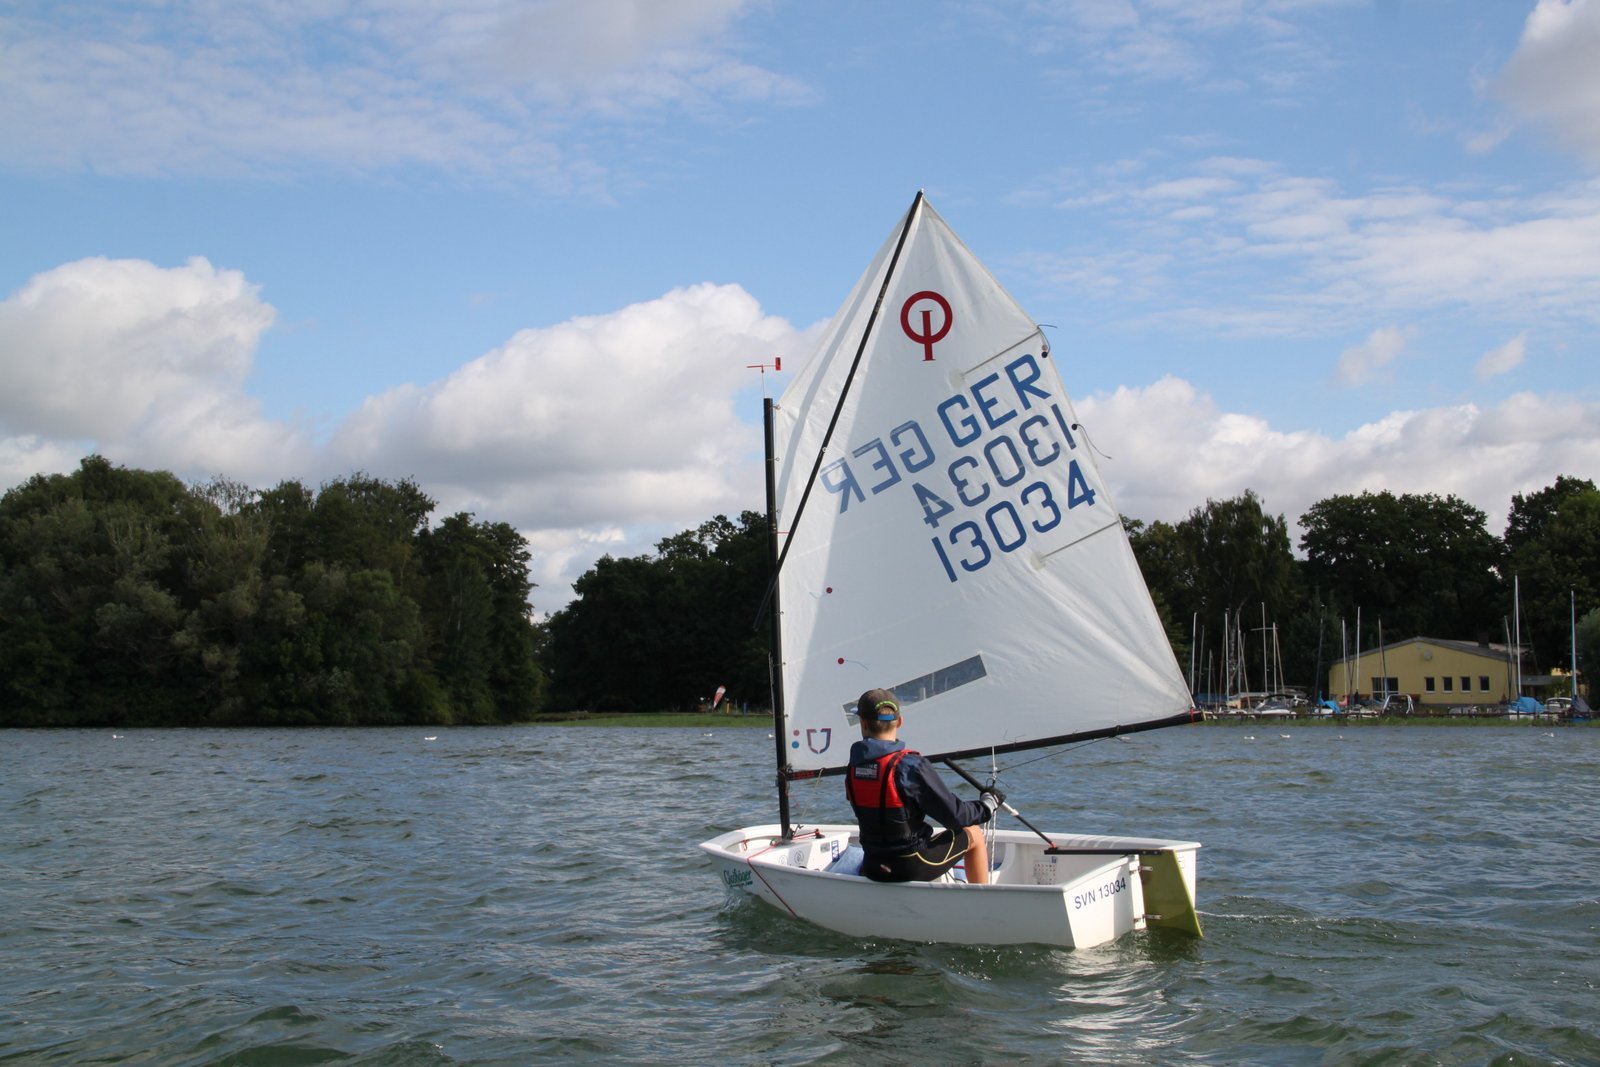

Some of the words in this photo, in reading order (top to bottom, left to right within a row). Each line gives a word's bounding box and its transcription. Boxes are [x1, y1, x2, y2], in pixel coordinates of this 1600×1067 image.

[937, 354, 1052, 448] GER
[931, 459, 1096, 583] 13034
[1074, 889, 1096, 910] SVN
[1098, 876, 1127, 900] 13034
